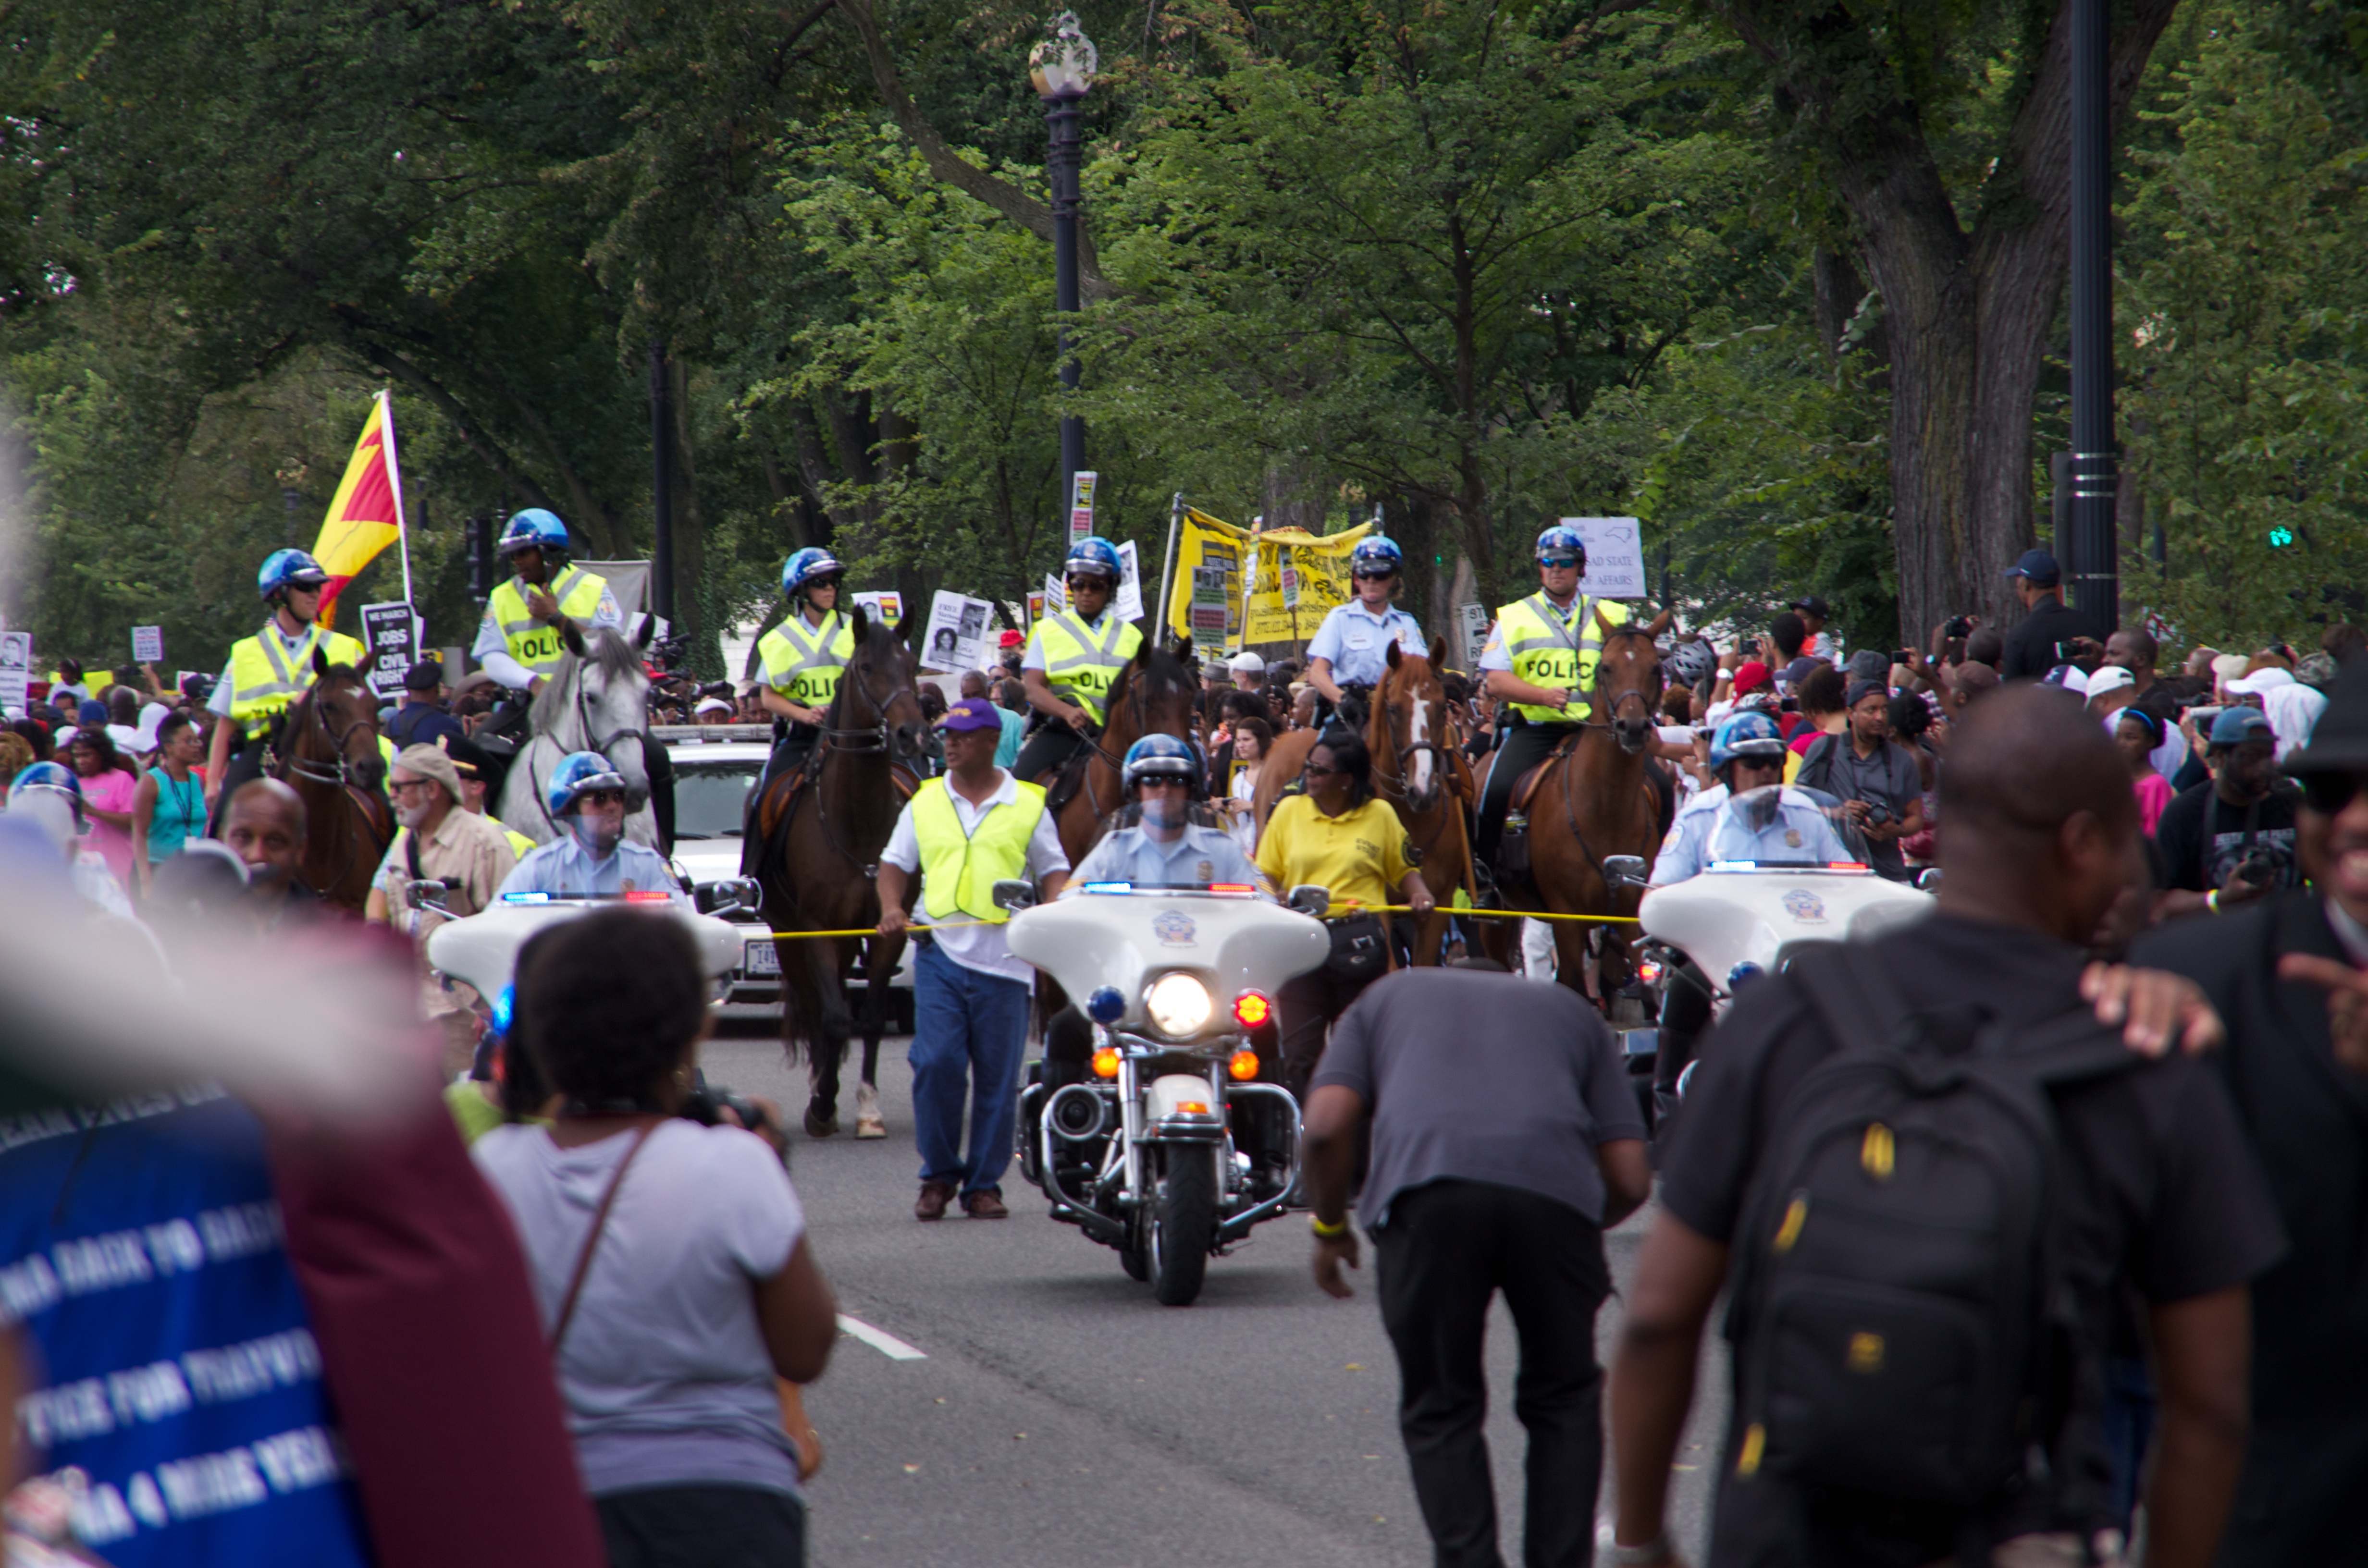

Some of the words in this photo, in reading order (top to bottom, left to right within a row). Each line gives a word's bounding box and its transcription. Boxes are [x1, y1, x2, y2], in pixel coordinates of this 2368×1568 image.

[1606, 556, 1633, 566] STATE
[1598, 575, 1633, 585] AFFAIRS
[376, 628, 408, 646] JOBS
[379, 652, 411, 669] CIVIL
[1526, 659, 1592, 679] POLIC
[375, 667, 411, 686] RIGHT
[142, 1217, 204, 1277] TO
